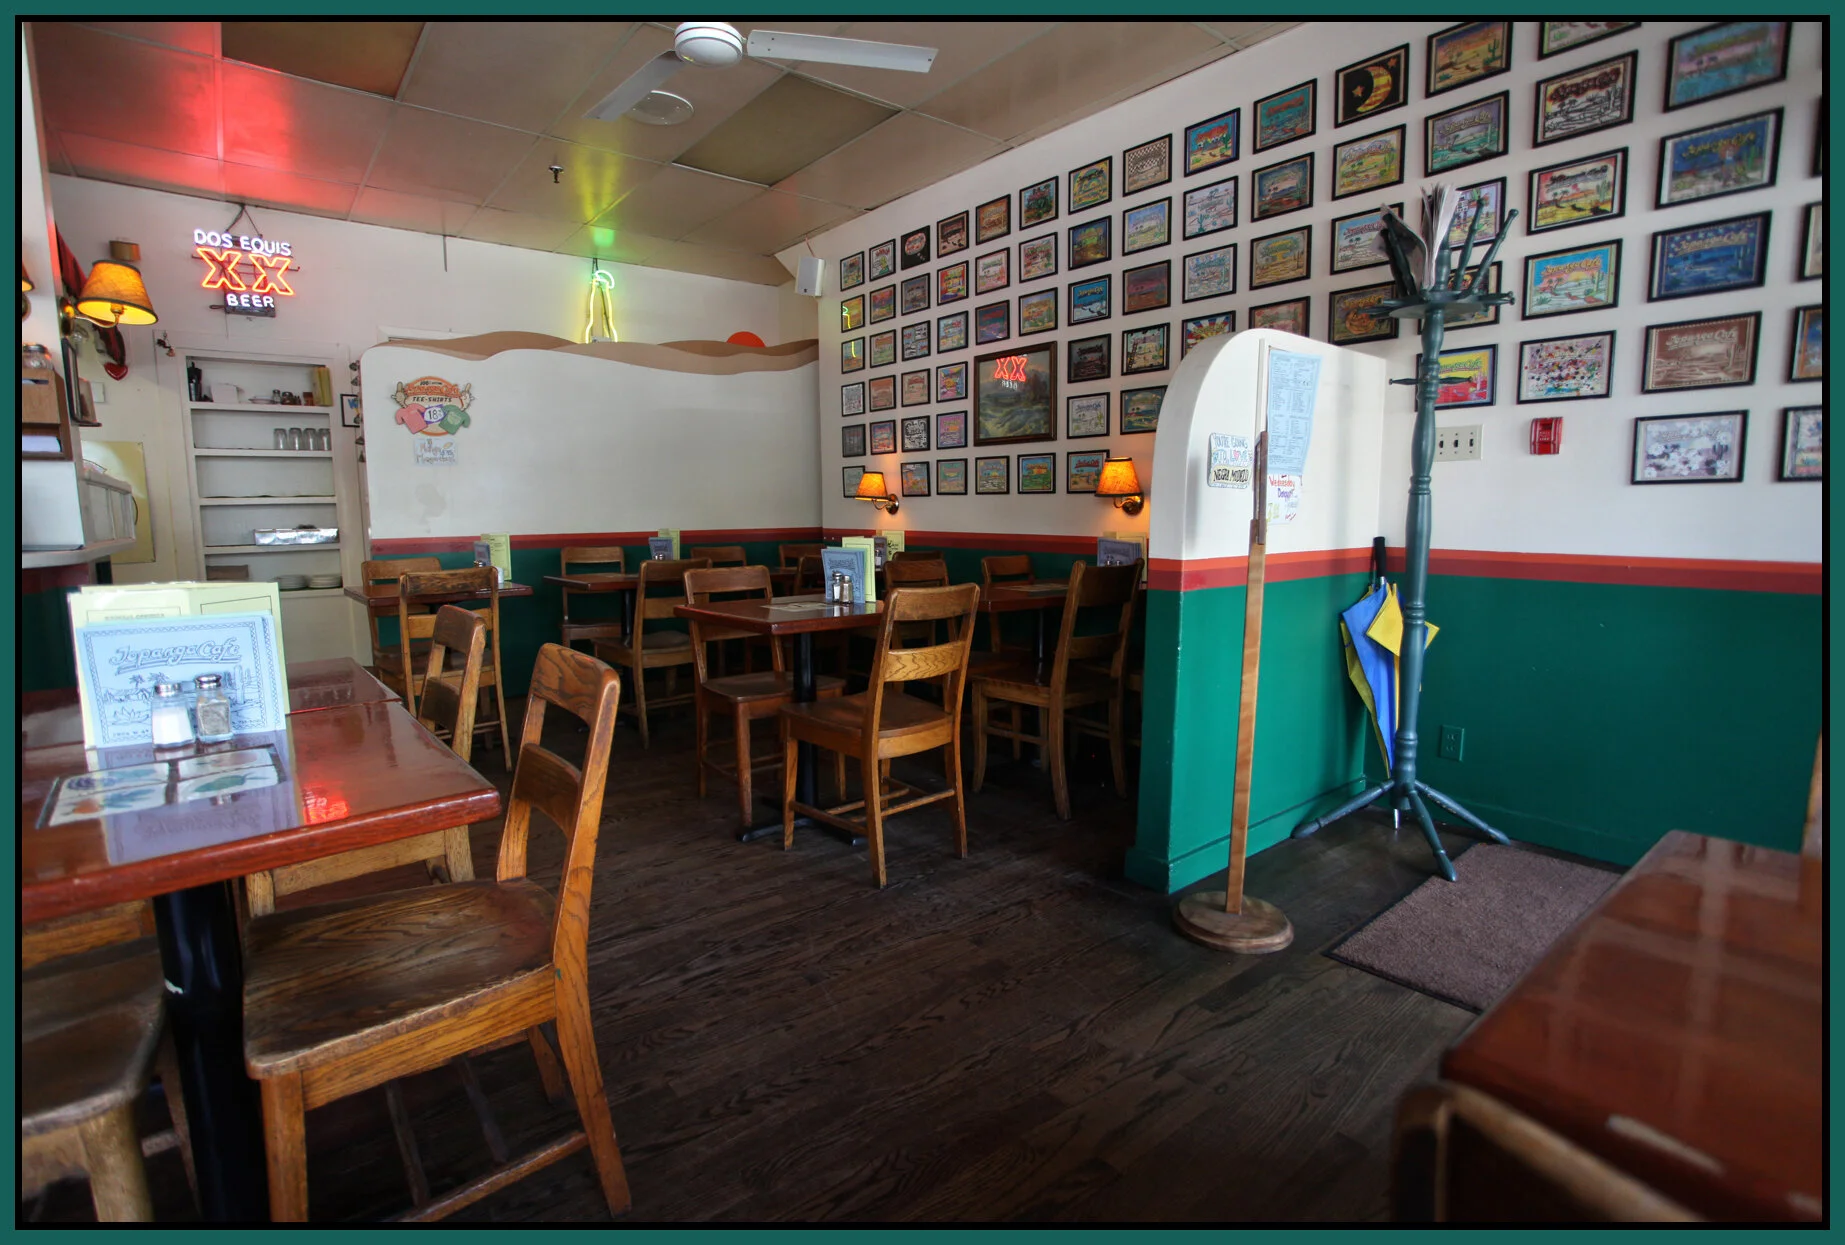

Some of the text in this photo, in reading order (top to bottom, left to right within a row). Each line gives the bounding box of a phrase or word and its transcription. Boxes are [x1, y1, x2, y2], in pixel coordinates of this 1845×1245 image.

[194, 228, 292, 257] DOS EQUIS
[196, 247, 295, 296] XX
[226, 293, 275, 308] BEER
[109, 637, 240, 669] Topanga Cafe
